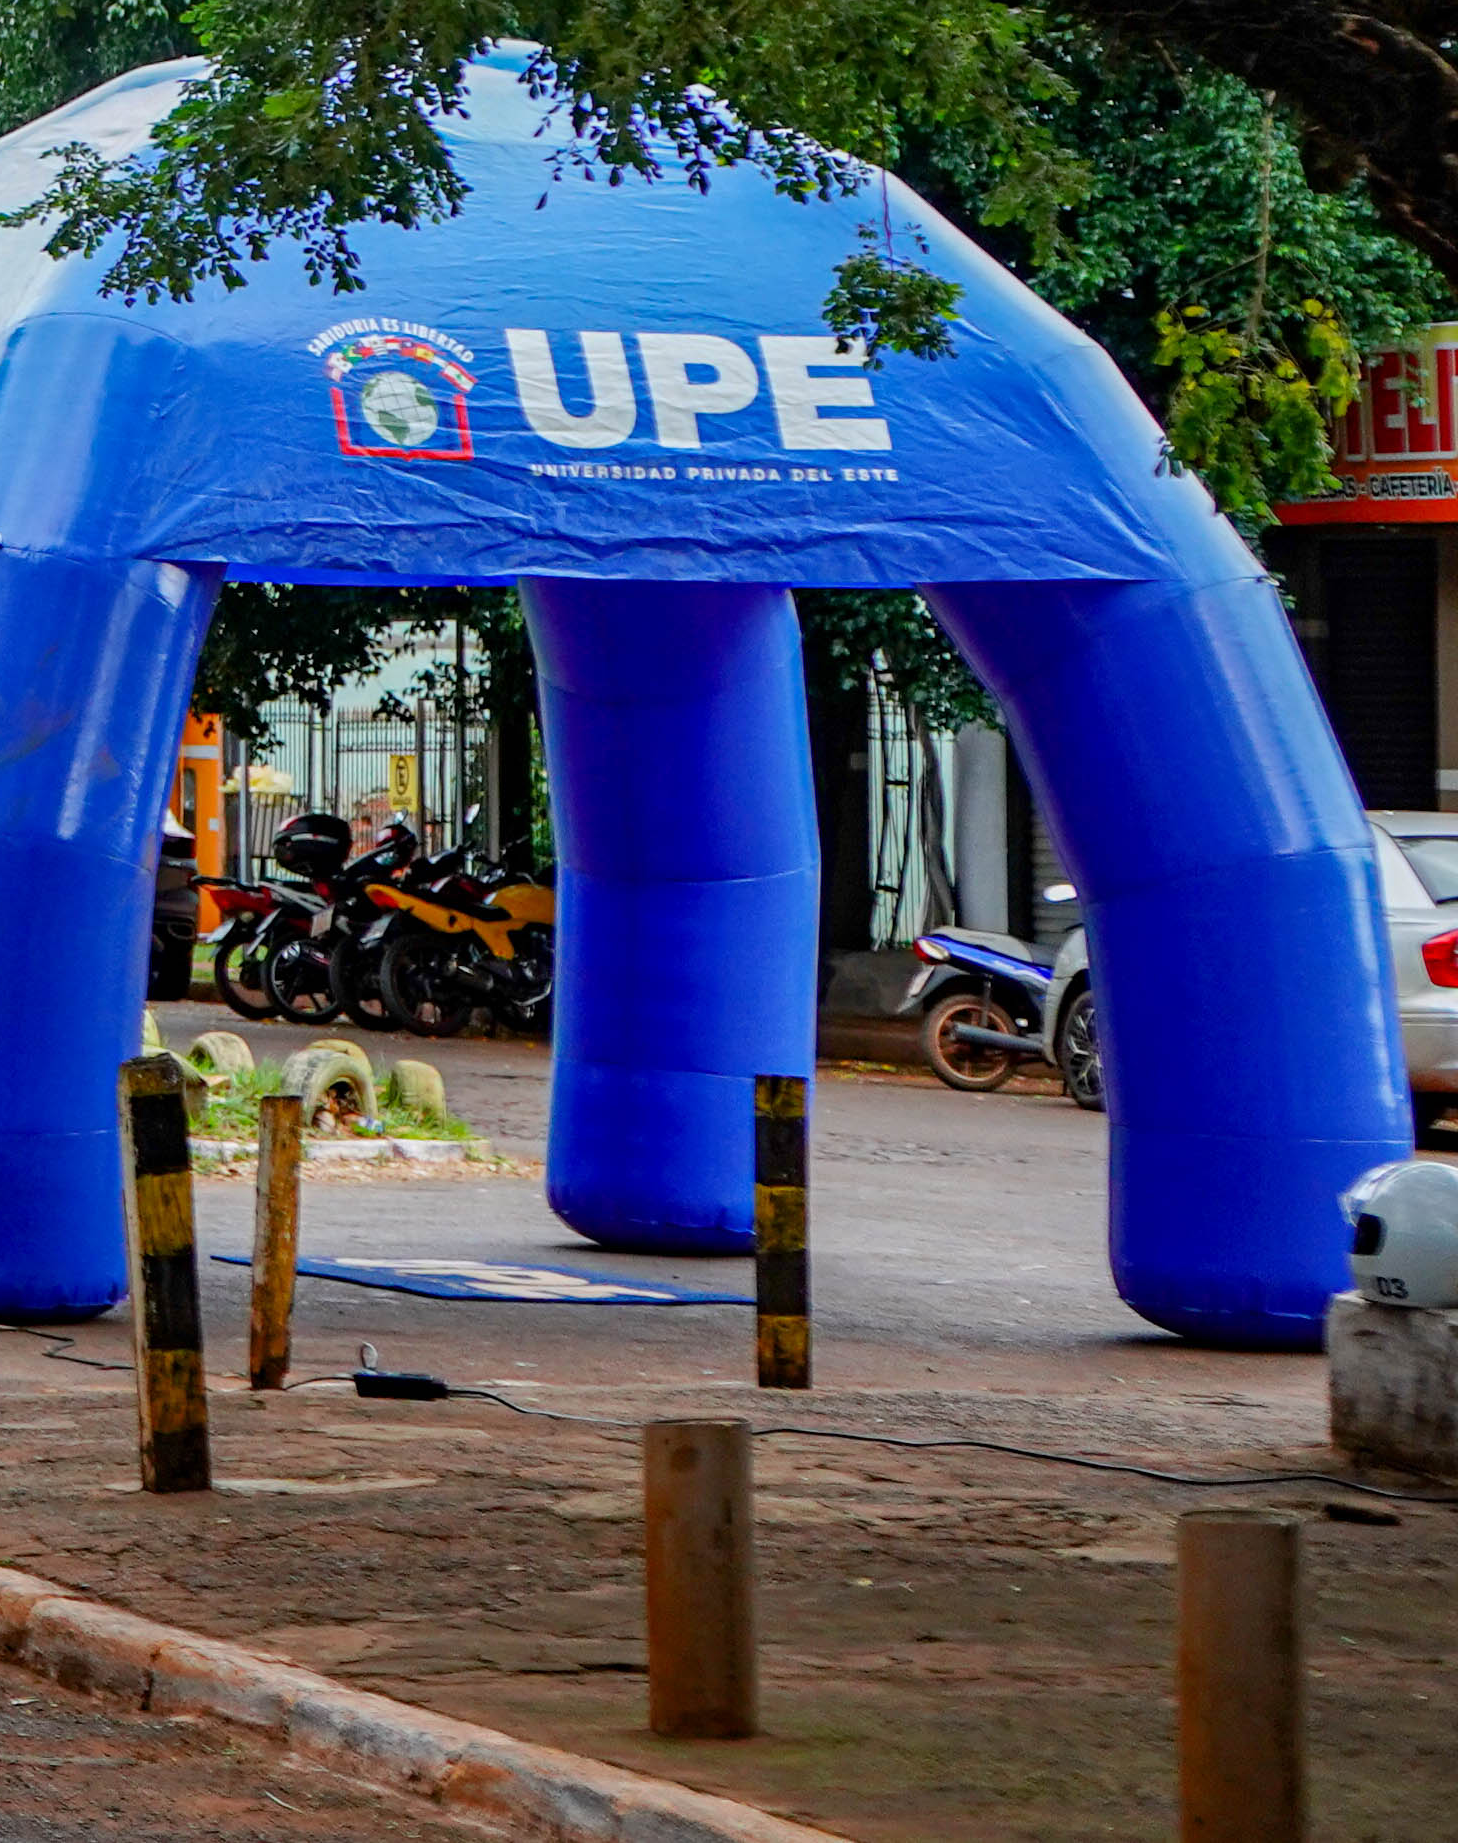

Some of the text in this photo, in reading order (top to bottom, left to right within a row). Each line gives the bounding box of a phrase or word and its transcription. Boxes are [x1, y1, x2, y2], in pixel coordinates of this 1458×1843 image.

[307, 317, 475, 363] SABIDURIA ES LIBERTAD
[504, 328, 893, 452] UPE
[530, 463, 899, 482] UNIVERSIDAD PRIVADA DEL ESTE
[1369, 466, 1456, 500] CAFETERÍA
[1376, 1276, 1409, 1299] 03
